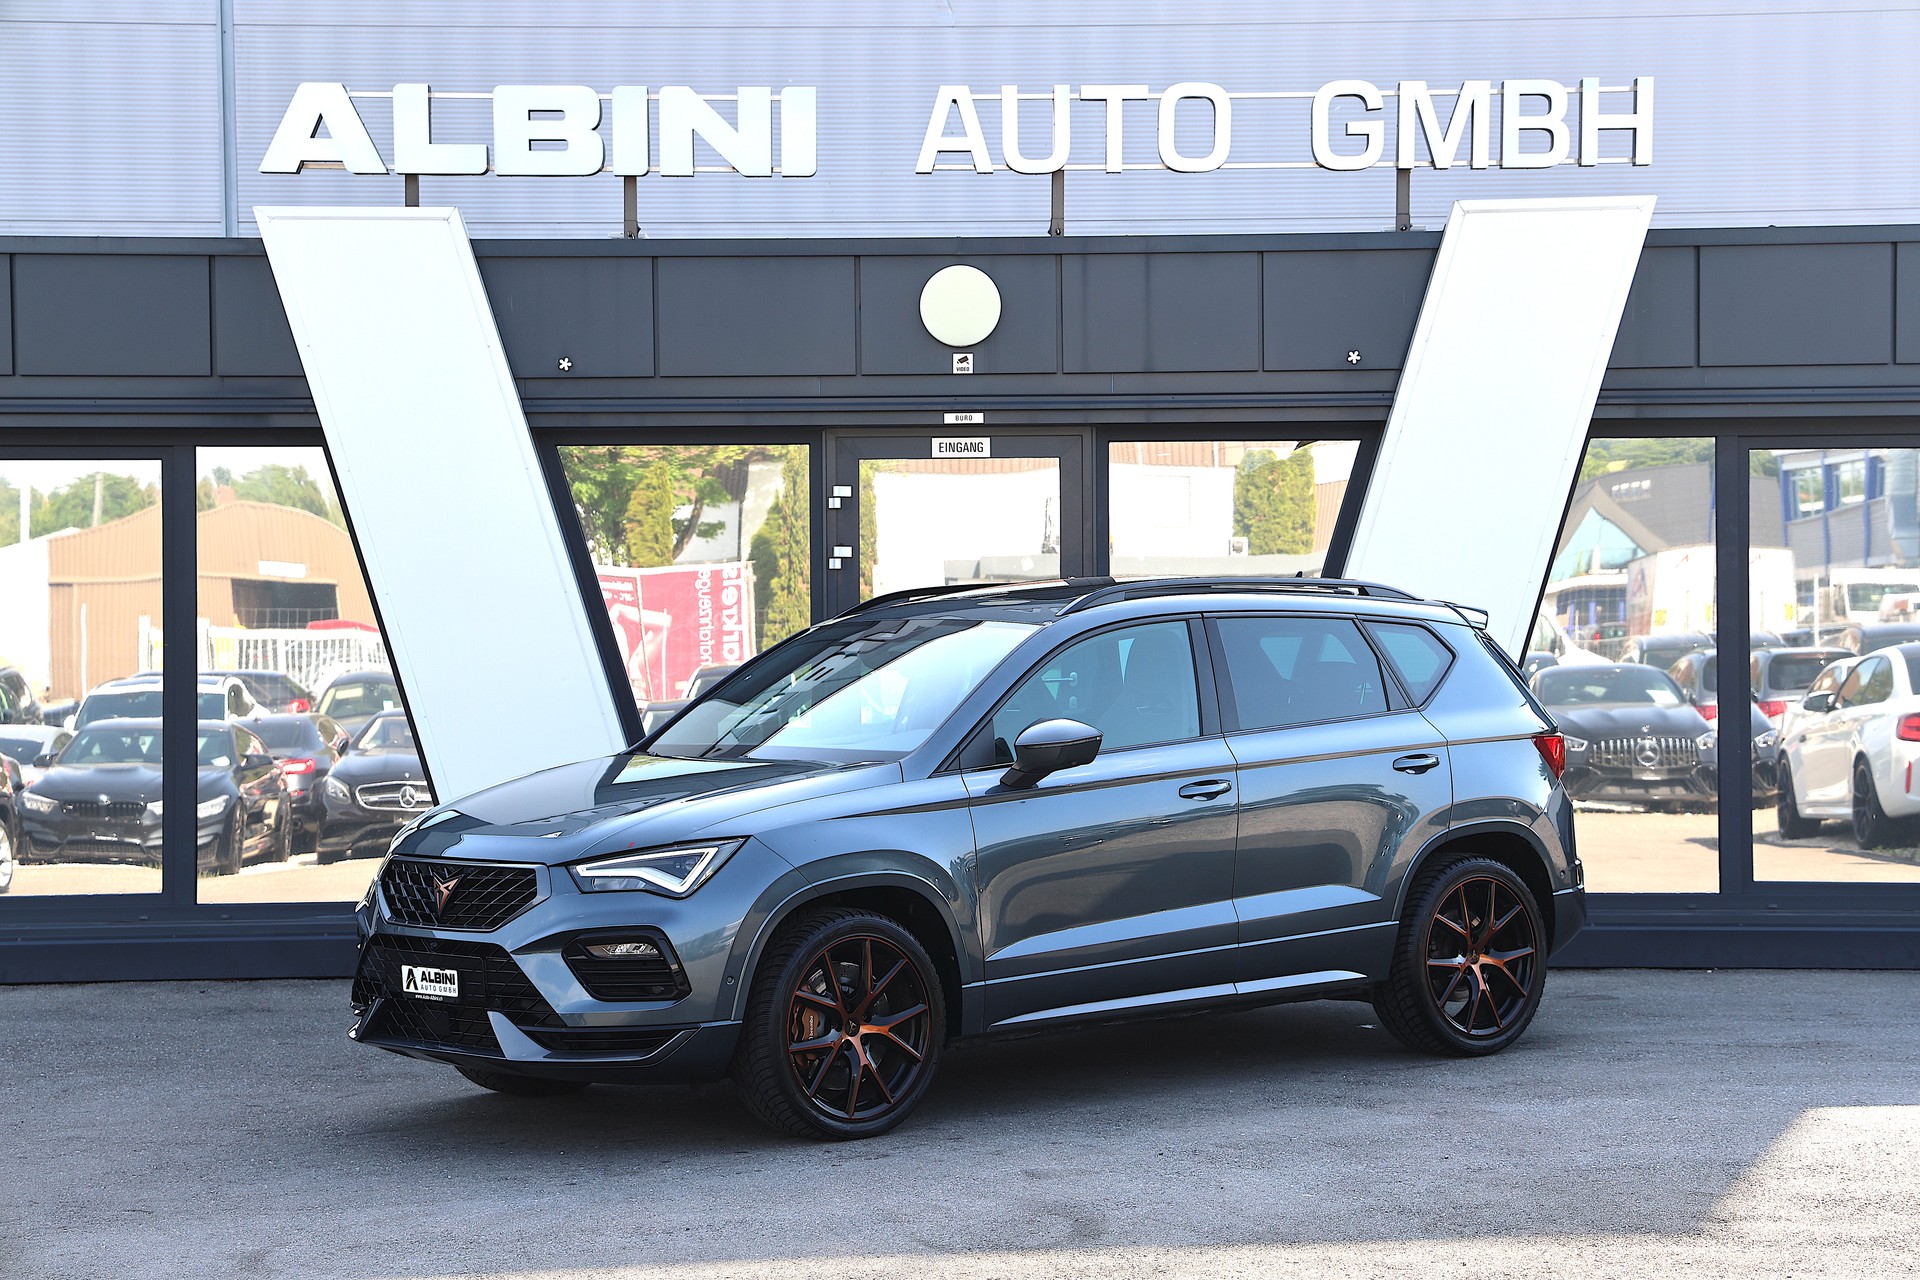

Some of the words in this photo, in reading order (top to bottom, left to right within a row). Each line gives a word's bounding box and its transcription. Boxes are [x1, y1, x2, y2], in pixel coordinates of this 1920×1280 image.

[257, 81, 817, 177] ALBINI
[914, 81, 1232, 175] AUTO
[1310, 76, 1655, 171] GMBH
[938, 441, 984, 453] EINGANG
[420, 970, 455, 985] ALBINI
[420, 984, 437, 992] AUTO
[438, 985, 457, 993] GMBH
